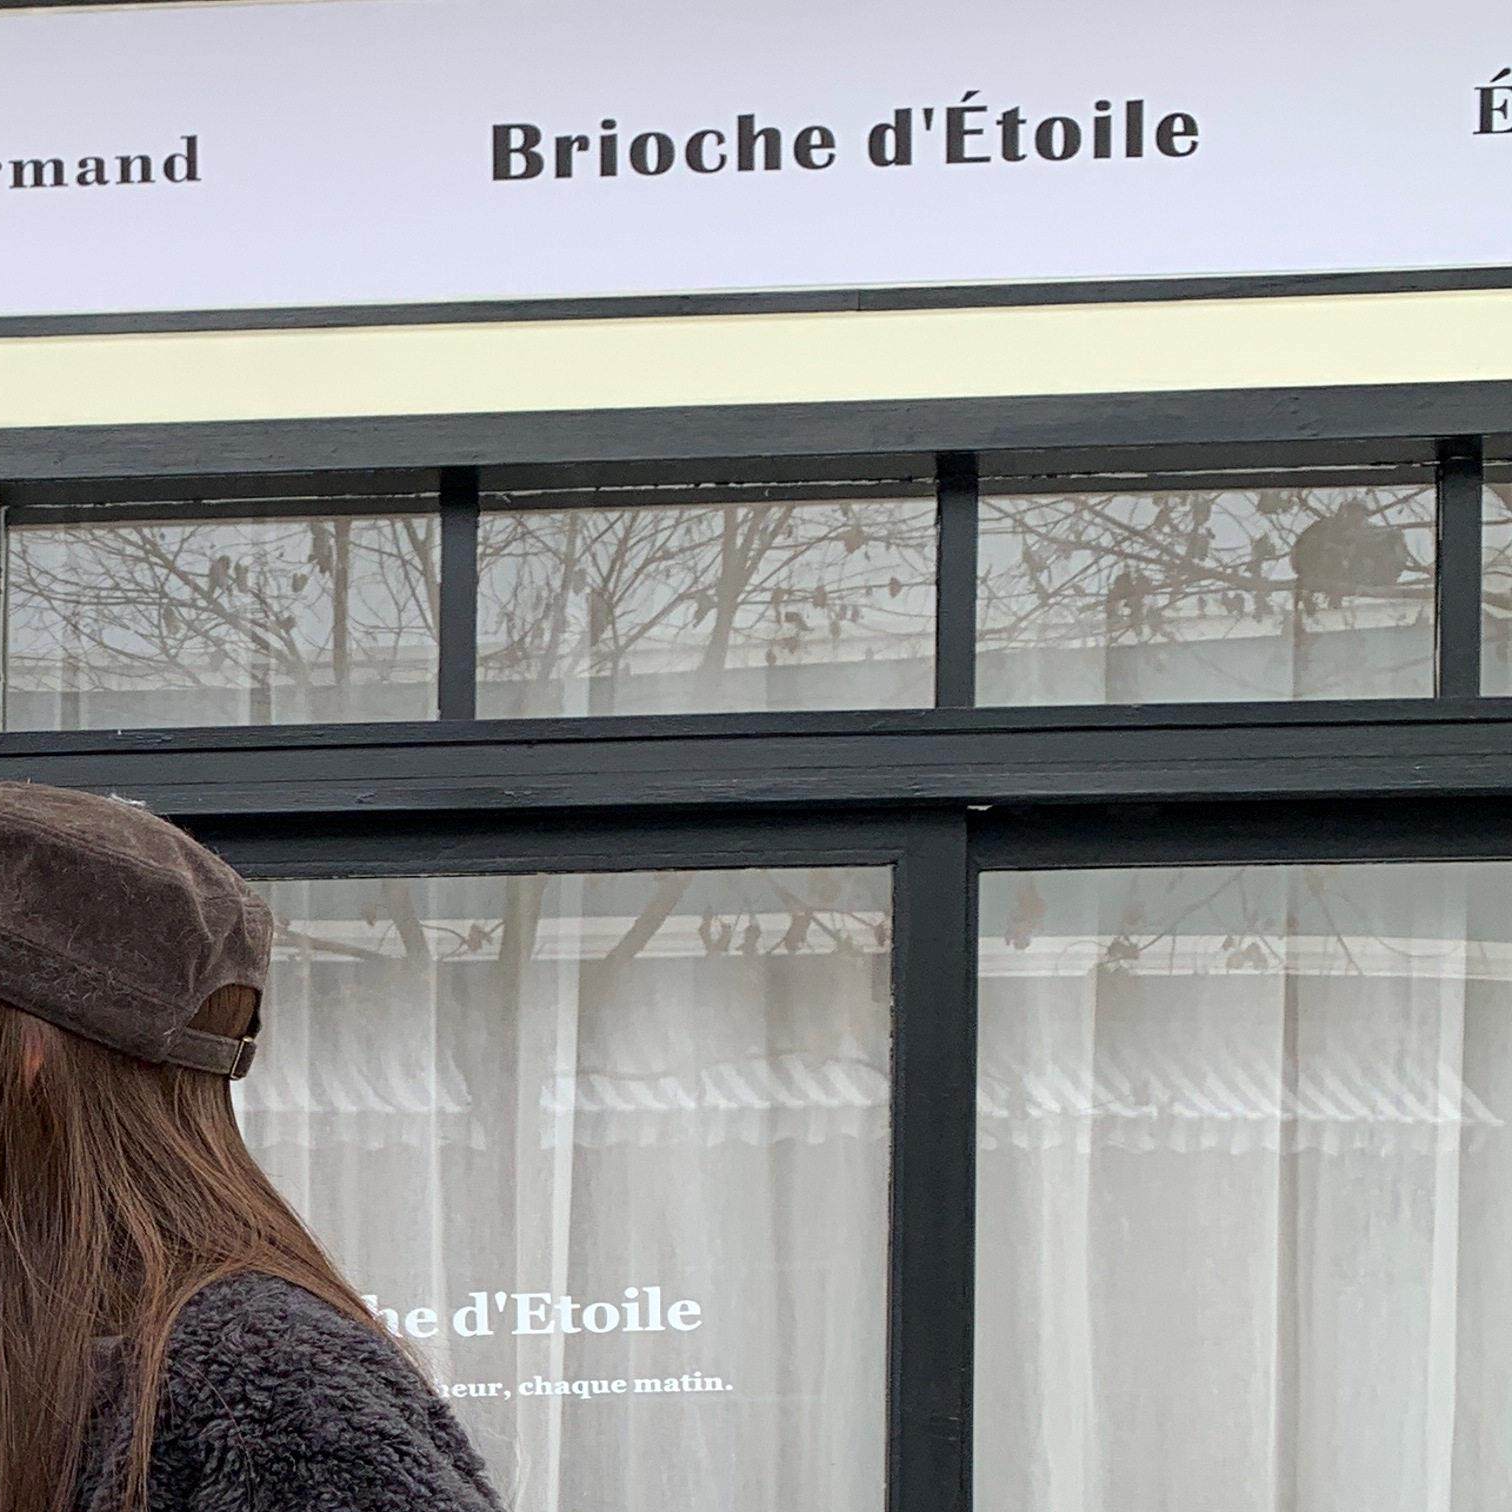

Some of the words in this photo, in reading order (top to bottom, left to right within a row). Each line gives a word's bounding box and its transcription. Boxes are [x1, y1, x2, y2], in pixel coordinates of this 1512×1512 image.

[491, 113, 836, 181] Brioche
[868, 90, 1200, 167] d'Étoile
[452, 1286, 703, 1338] d'Etoile
[518, 1375, 627, 1400] chaque
[632, 1371, 734, 1394] matin.
